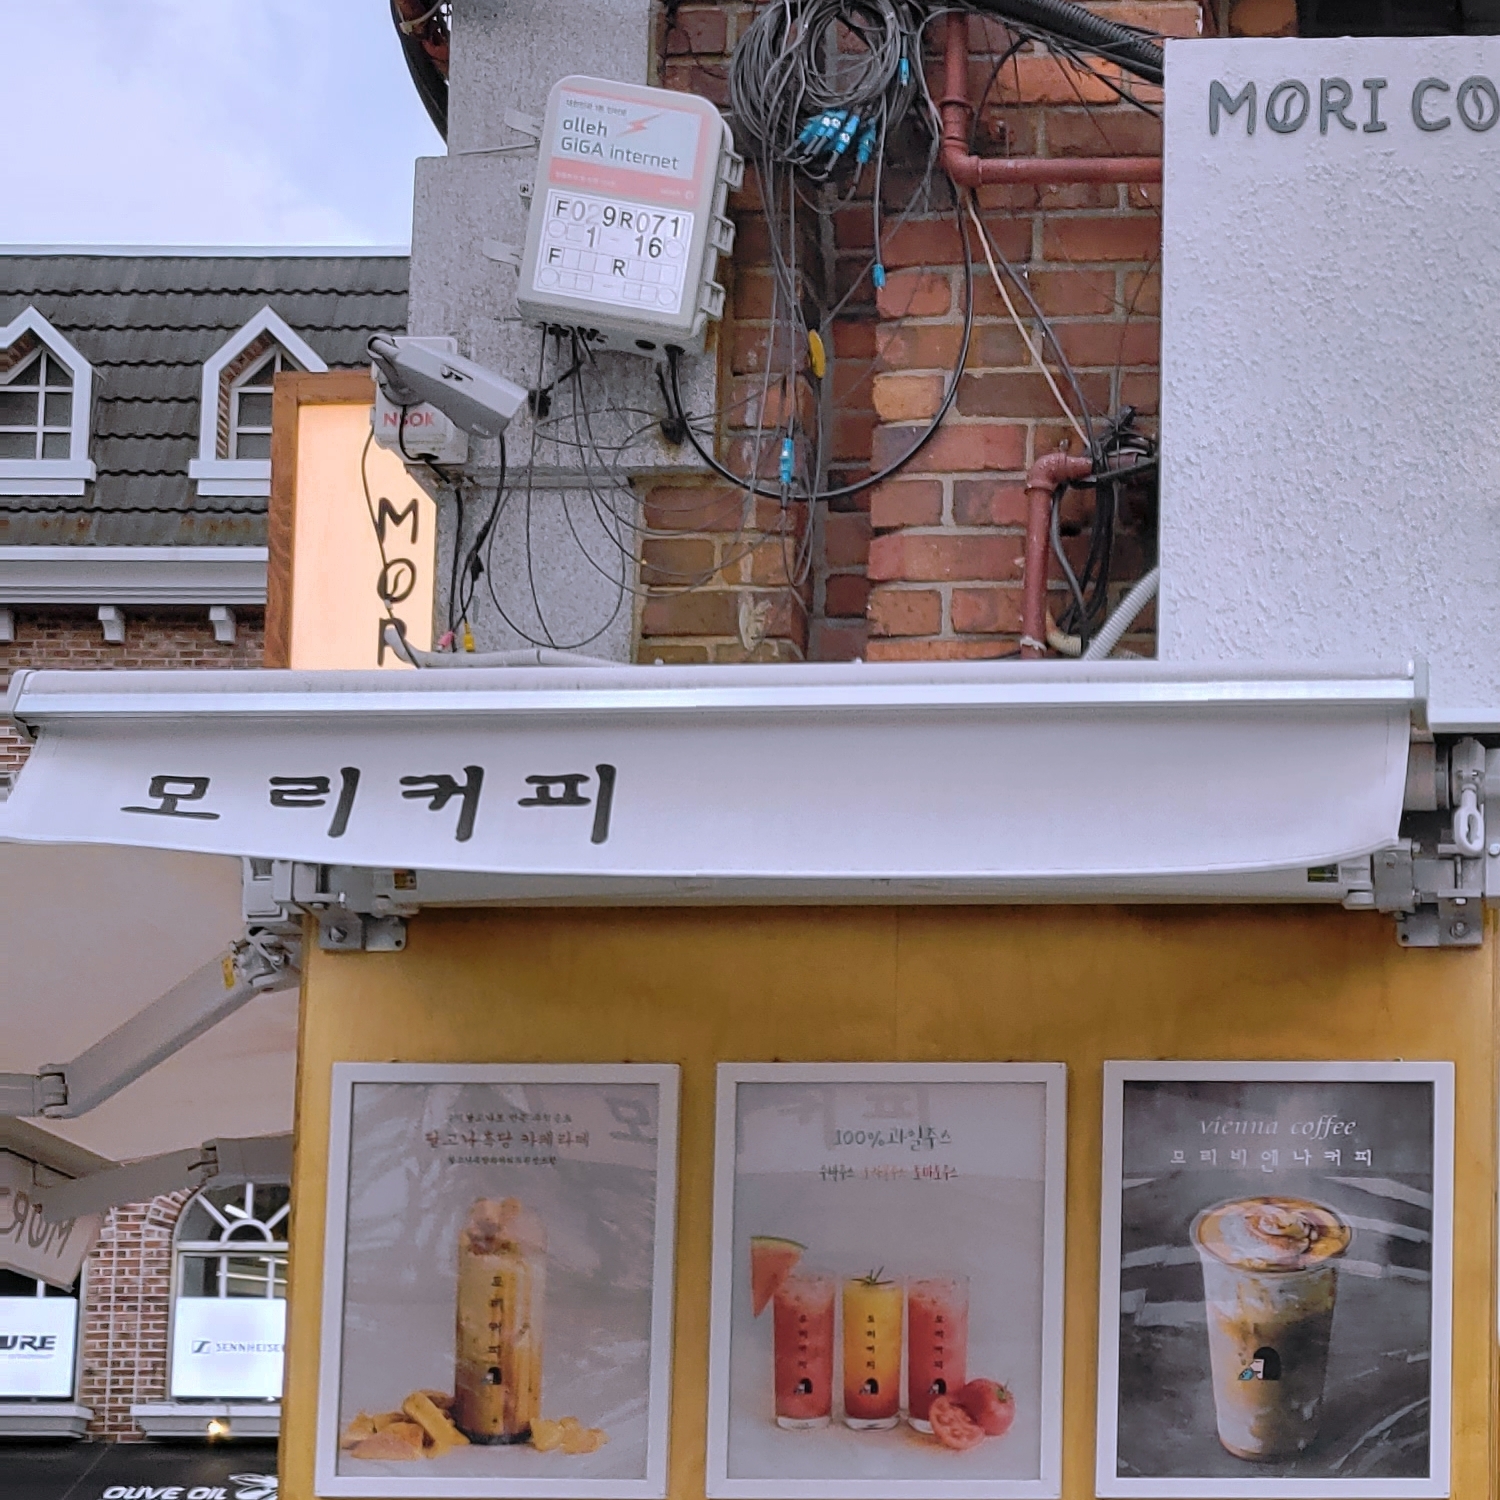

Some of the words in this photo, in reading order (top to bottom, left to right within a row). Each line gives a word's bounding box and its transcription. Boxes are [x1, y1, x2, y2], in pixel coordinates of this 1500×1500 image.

[1208, 77, 1388, 135] MORI
[563, 116, 608, 138] olleh
[609, 144, 680, 172] internet
[120, 763, 617, 845] 모리커피
[1200, 1115, 1278, 1136] vienna
[1290, 1114, 1357, 1140] coffee
[1170, 1148, 1372, 1173] 모리비엔나커피
[215, 1342, 284, 1353] SENNHEISE
[103, 1485, 186, 1500] OLIVE
